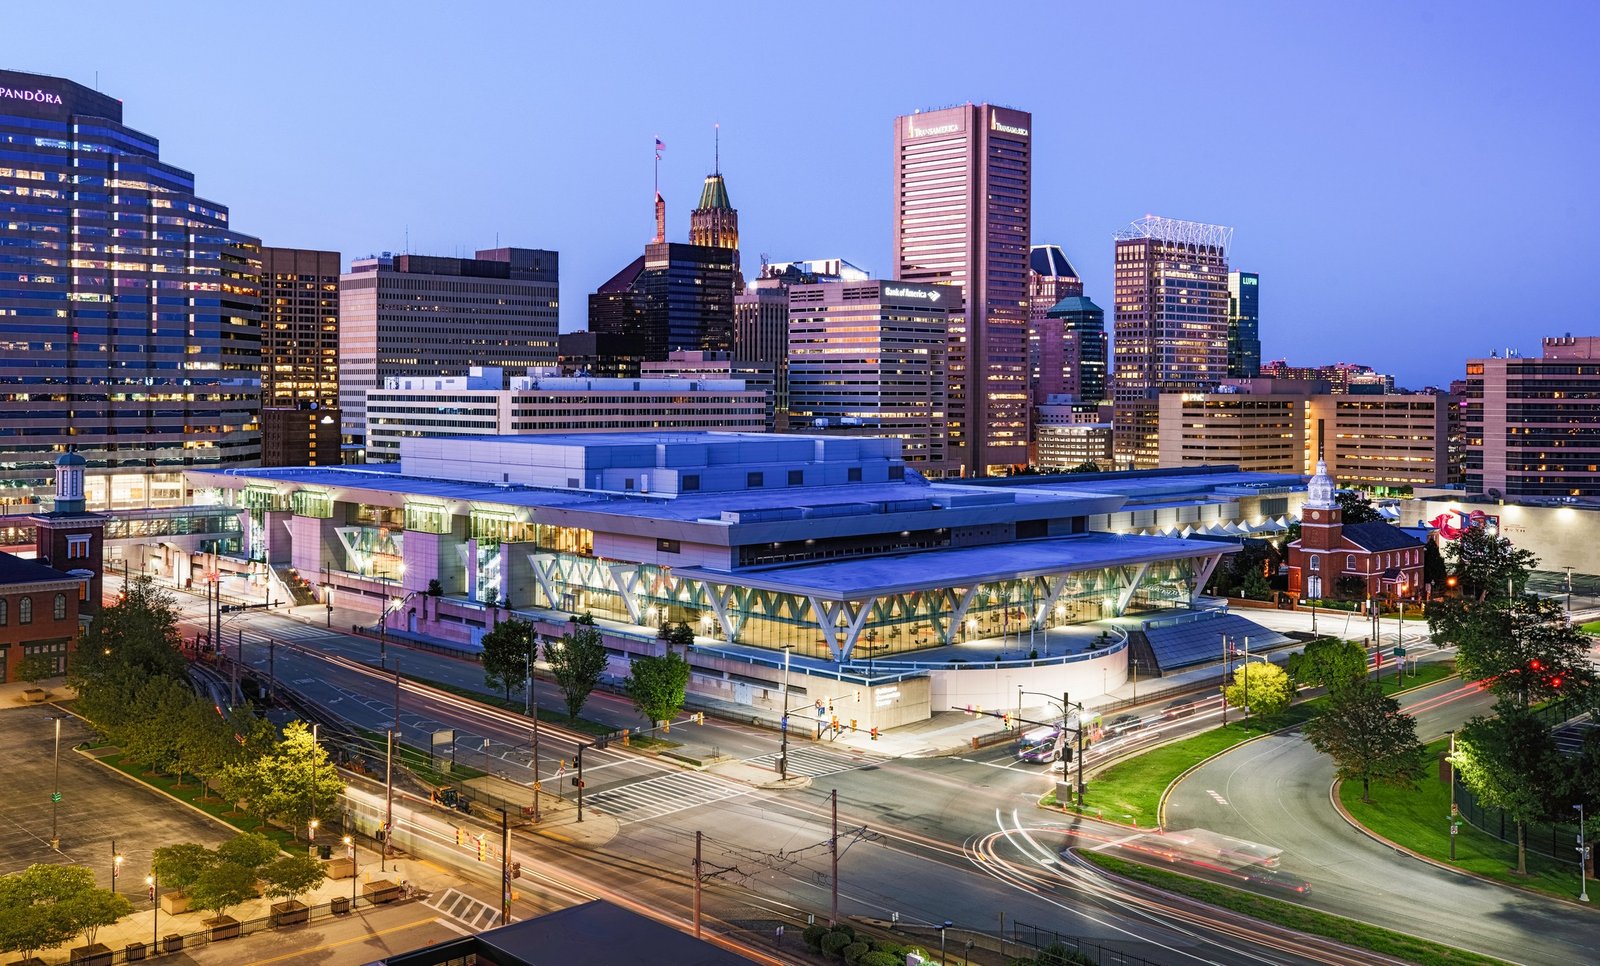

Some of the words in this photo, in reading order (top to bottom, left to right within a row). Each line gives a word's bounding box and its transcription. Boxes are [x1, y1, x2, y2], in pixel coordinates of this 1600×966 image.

[1242, 277, 1257, 286] LUPIN
[885, 287, 899, 297] Bank
[900, 288, 905, 297] of
[906, 288, 927, 298] America
